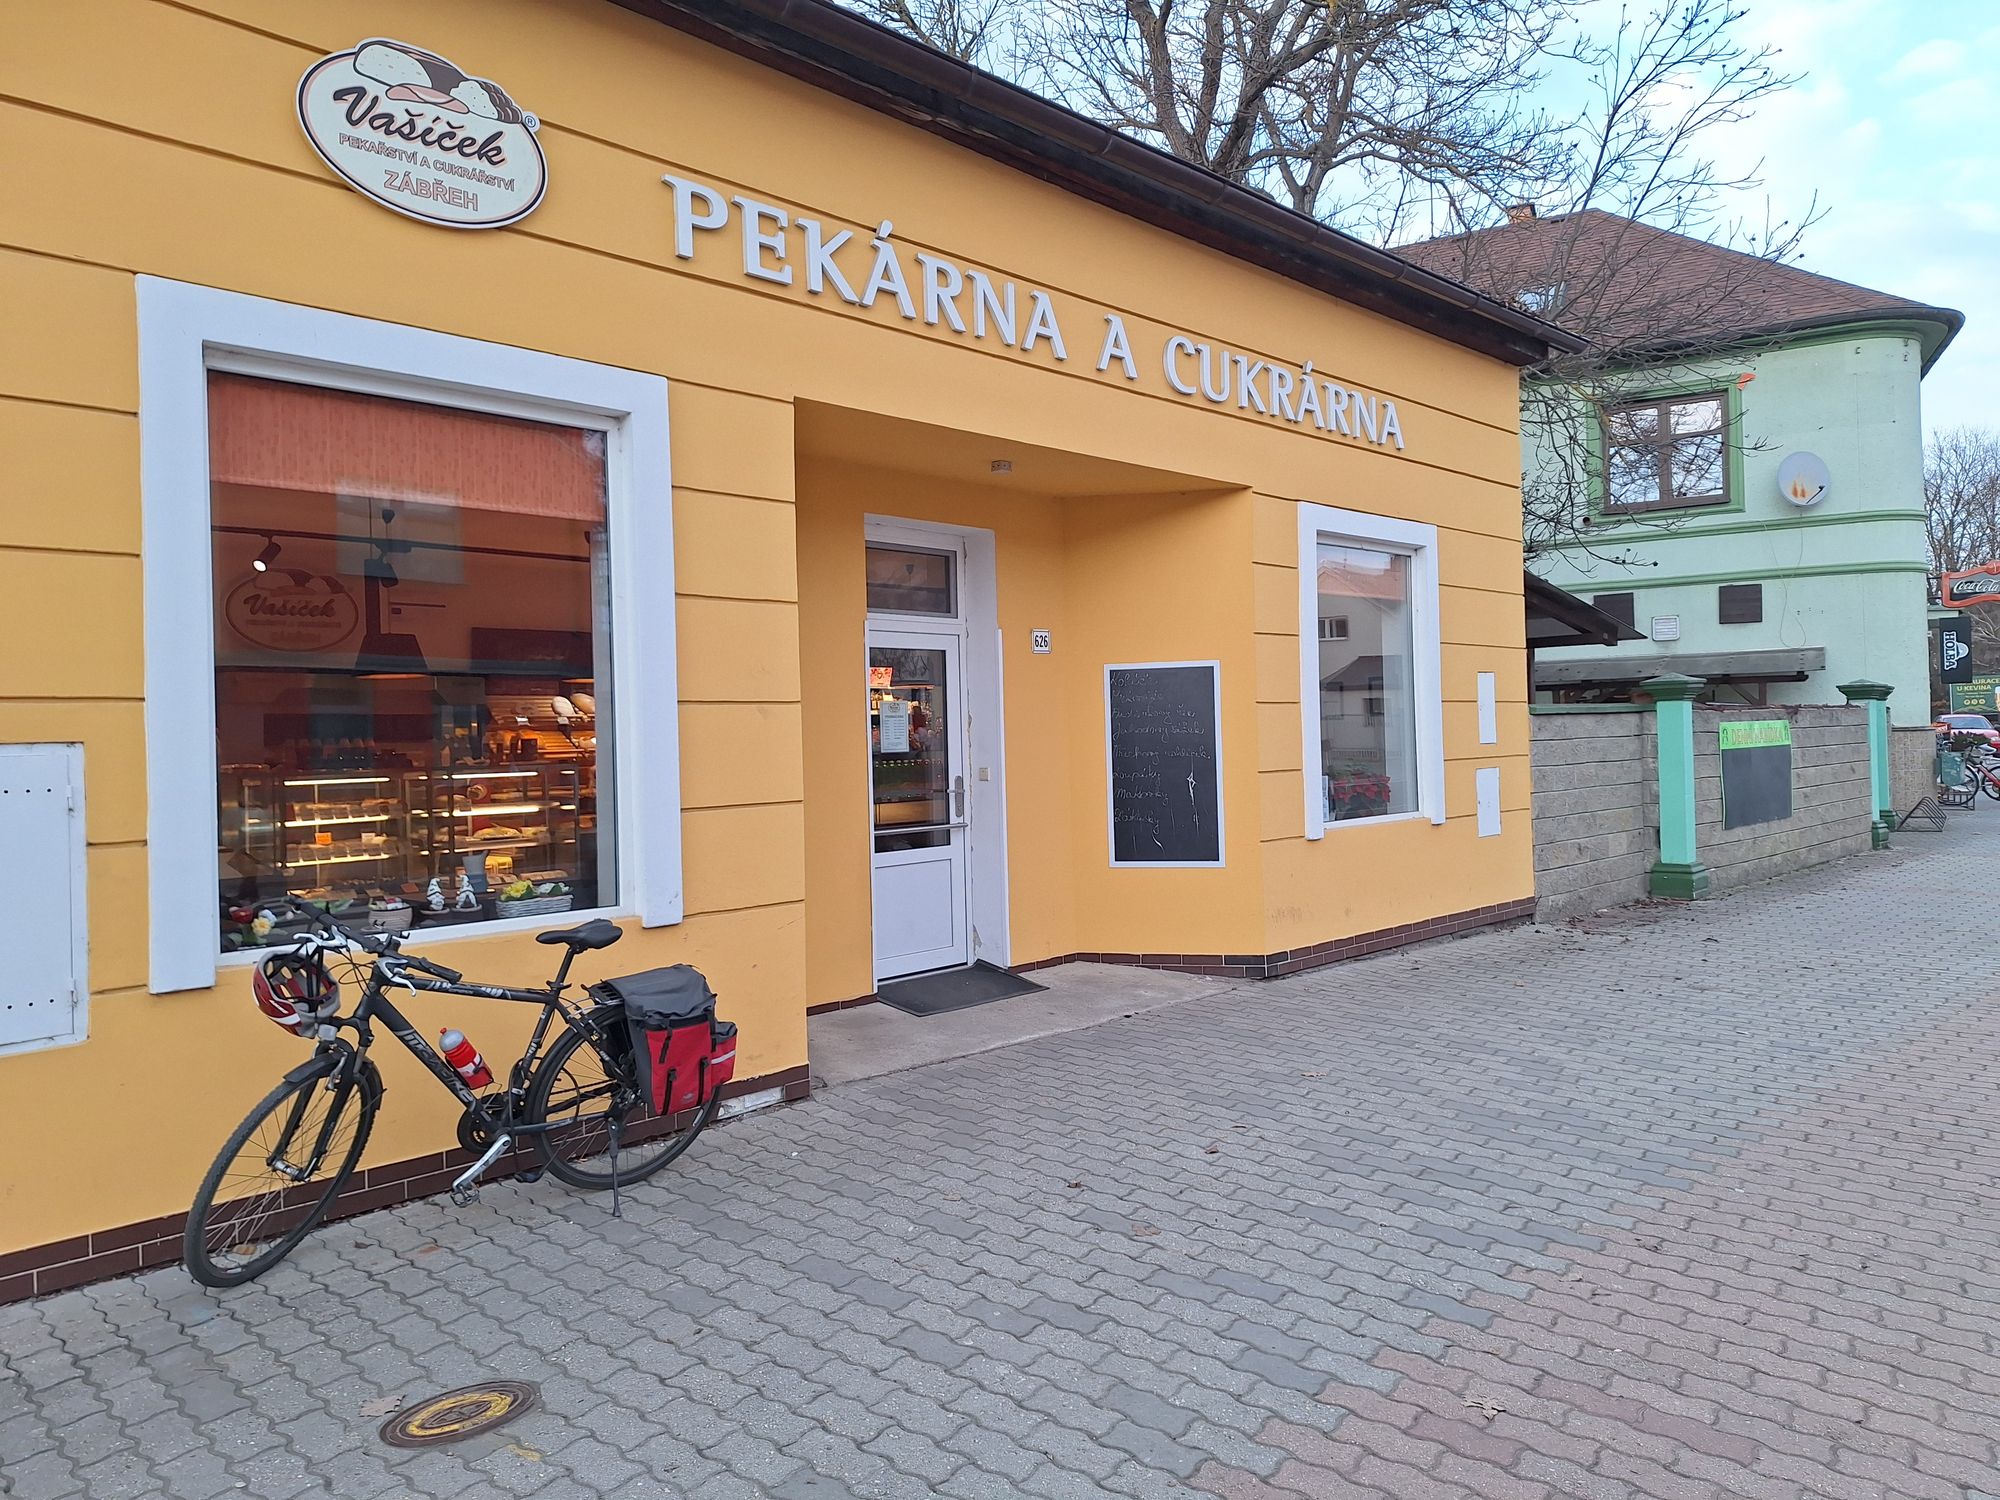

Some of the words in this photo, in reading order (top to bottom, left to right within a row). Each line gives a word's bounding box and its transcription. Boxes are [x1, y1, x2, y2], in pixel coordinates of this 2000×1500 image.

[332, 86, 506, 166] Vašíček
[338, 132, 418, 165] PEKAŘSTVÍ
[420, 156, 431, 169] A
[433, 159, 515, 192] CUKRÁŘSTVÍ
[383, 169, 479, 212] ZÁBŘEH
[660, 173, 1068, 361] PEKÁRNA
[1096, 313, 1138, 381] A
[1162, 335, 1405, 450] CUKRÁRNA
[1034, 634, 1048, 648] 626
[1943, 631, 1957, 670] HOLBA
